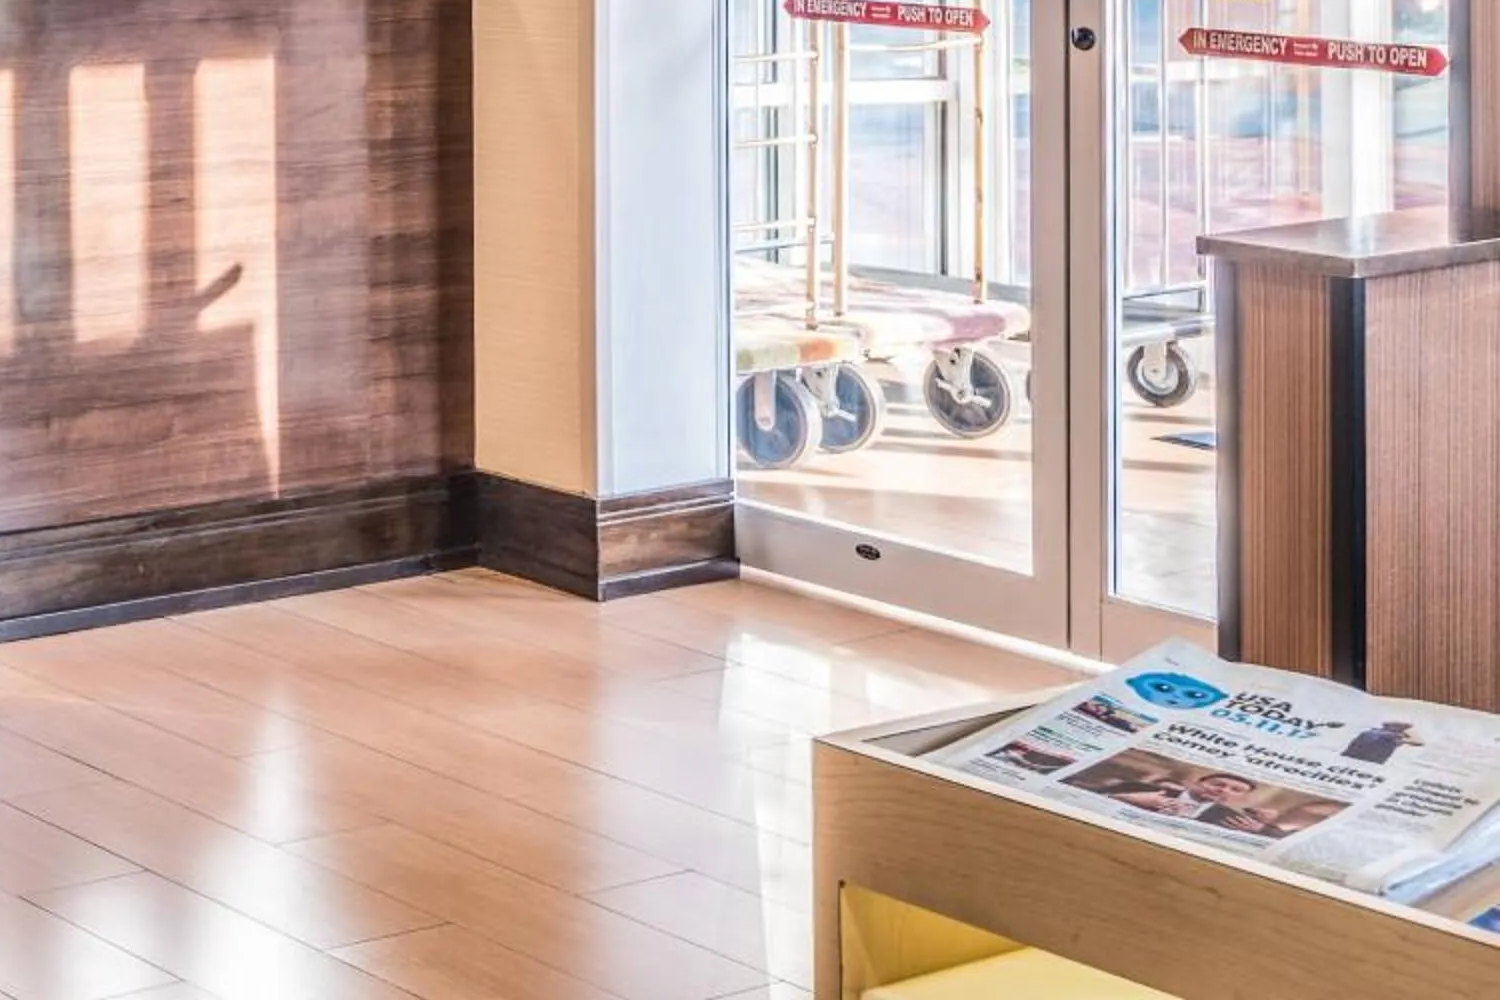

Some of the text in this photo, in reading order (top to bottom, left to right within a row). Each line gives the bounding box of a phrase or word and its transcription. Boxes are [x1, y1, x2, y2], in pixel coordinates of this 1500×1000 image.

[897, 4, 926, 23] PUSH
[928, 7, 943, 24] TO
[945, 8, 974, 27] OPEN
[1193, 31, 1428, 69] IN EMERGENCY PUSH TO OPEN
[1225, 699, 1323, 730] TODAY
[1235, 691, 1292, 713] USA
[1210, 708, 1317, 738] 05.11.17
[1153, 731, 1237, 759] Comey
[1168, 723, 1386, 783] White House cites
